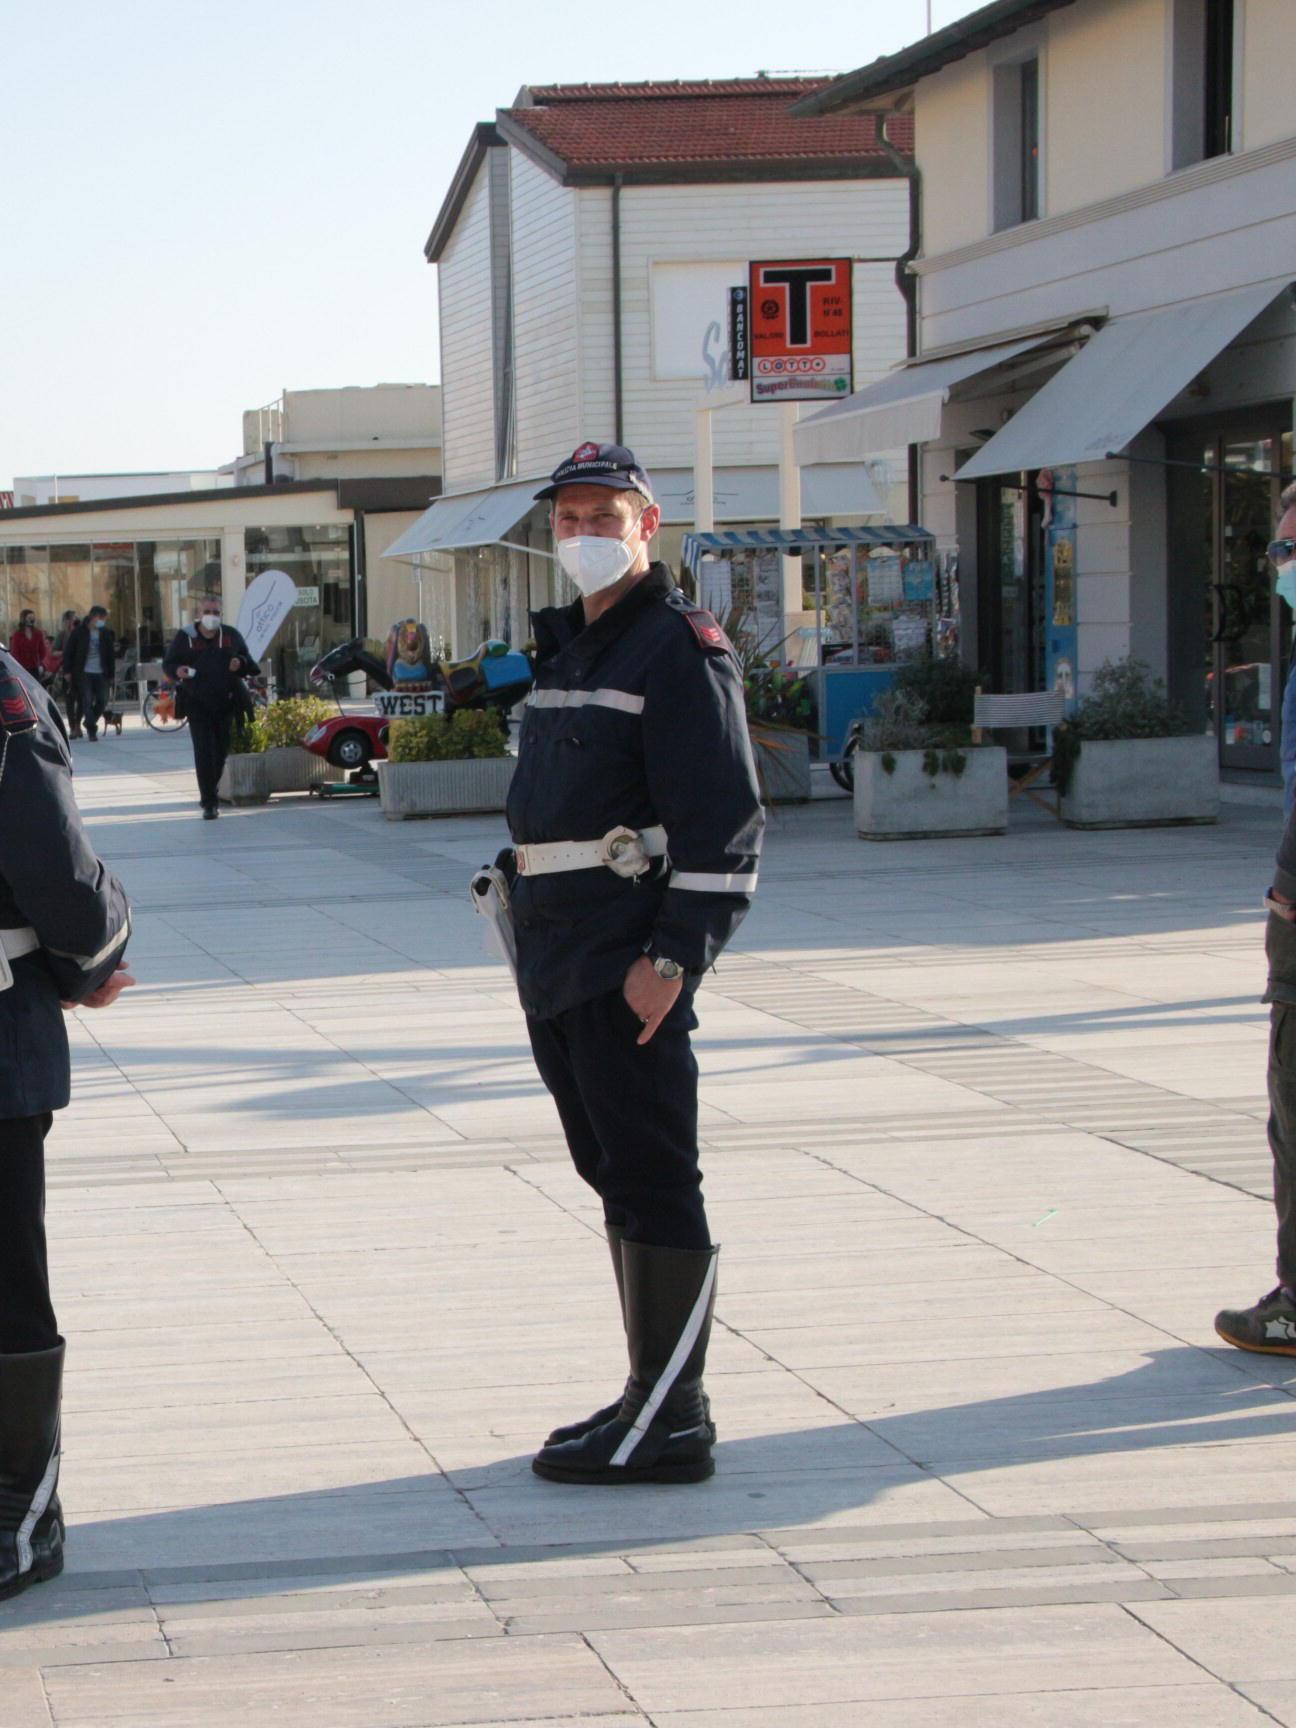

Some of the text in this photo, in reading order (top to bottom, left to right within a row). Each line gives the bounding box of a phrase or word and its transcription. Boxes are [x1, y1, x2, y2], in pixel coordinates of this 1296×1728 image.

[762, 267, 833, 345] T
[735, 303, 745, 378] BANCOMAT
[814, 329, 849, 337] BOLLATI
[380, 694, 442, 716] WEST
